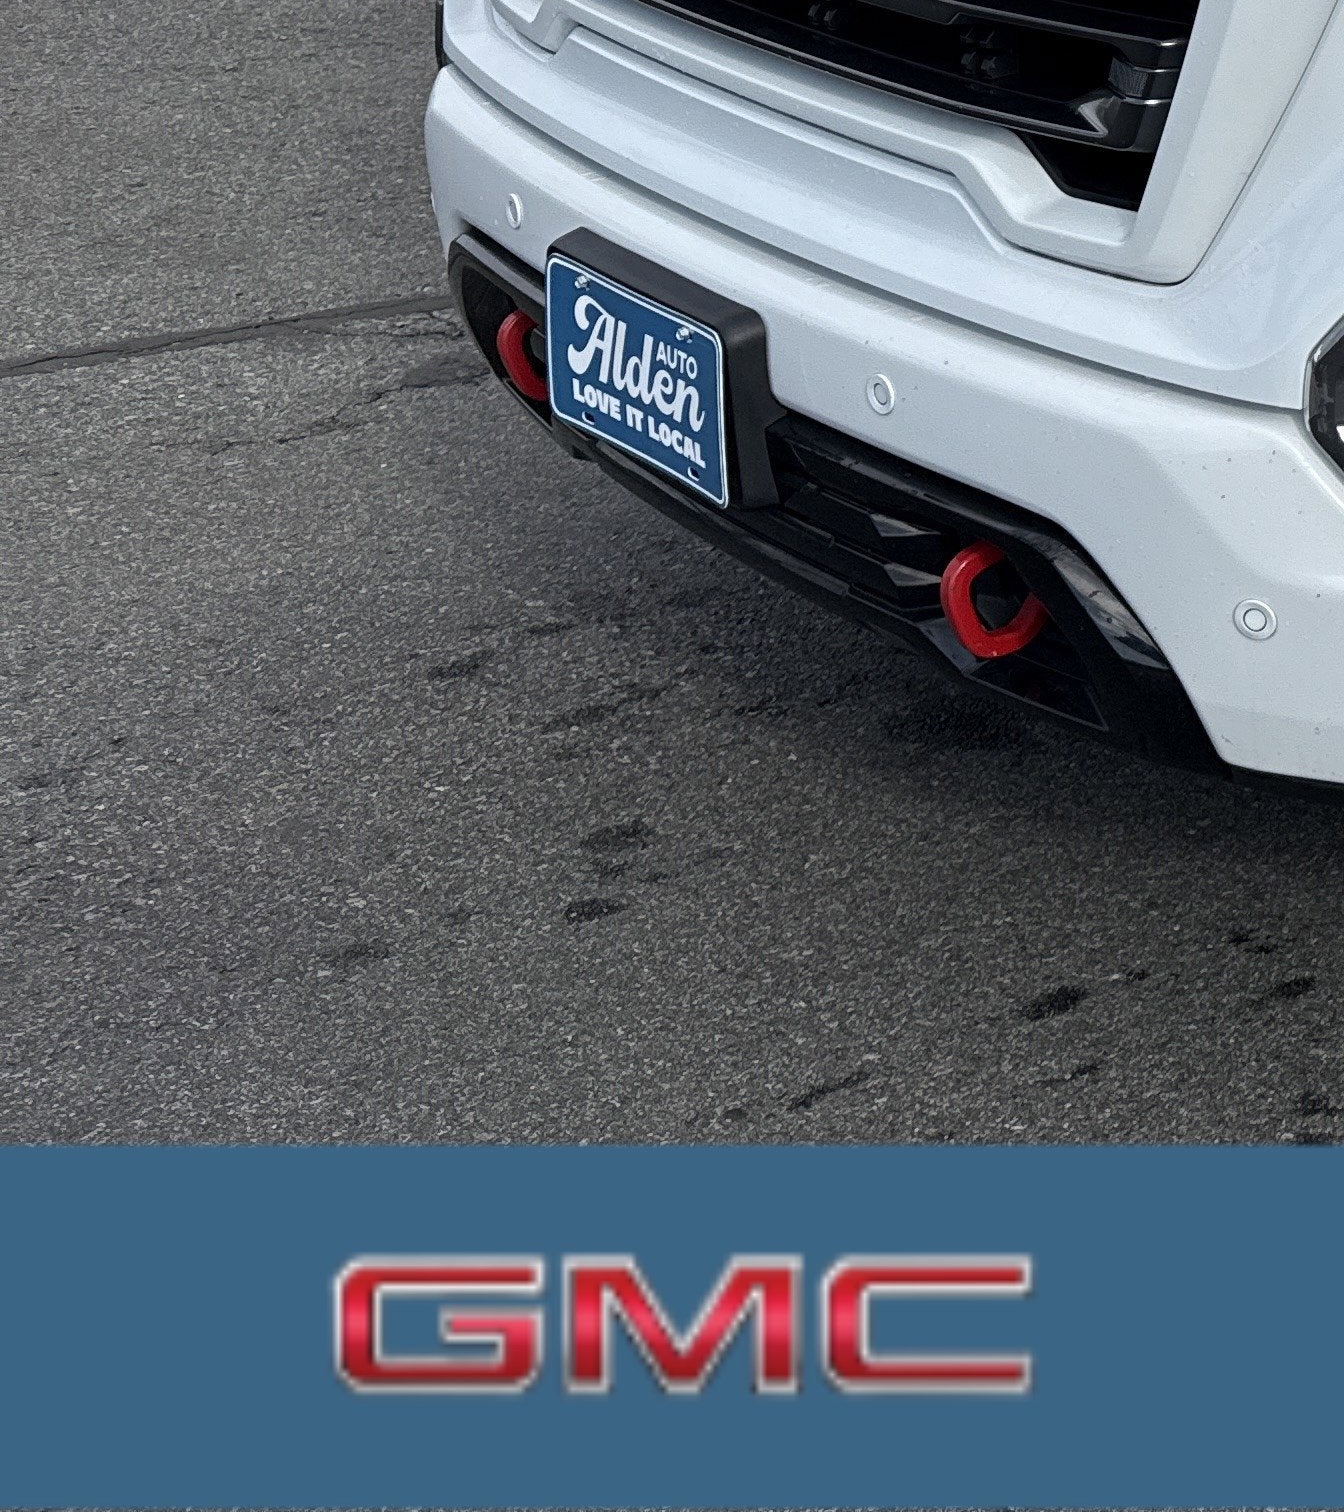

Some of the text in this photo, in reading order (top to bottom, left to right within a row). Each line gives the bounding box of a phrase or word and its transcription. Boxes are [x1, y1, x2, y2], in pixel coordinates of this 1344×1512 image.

[567, 294, 706, 432] Alden
[656, 342, 698, 380] AUTO
[572, 378, 706, 469] LOVE IT LOCAL
